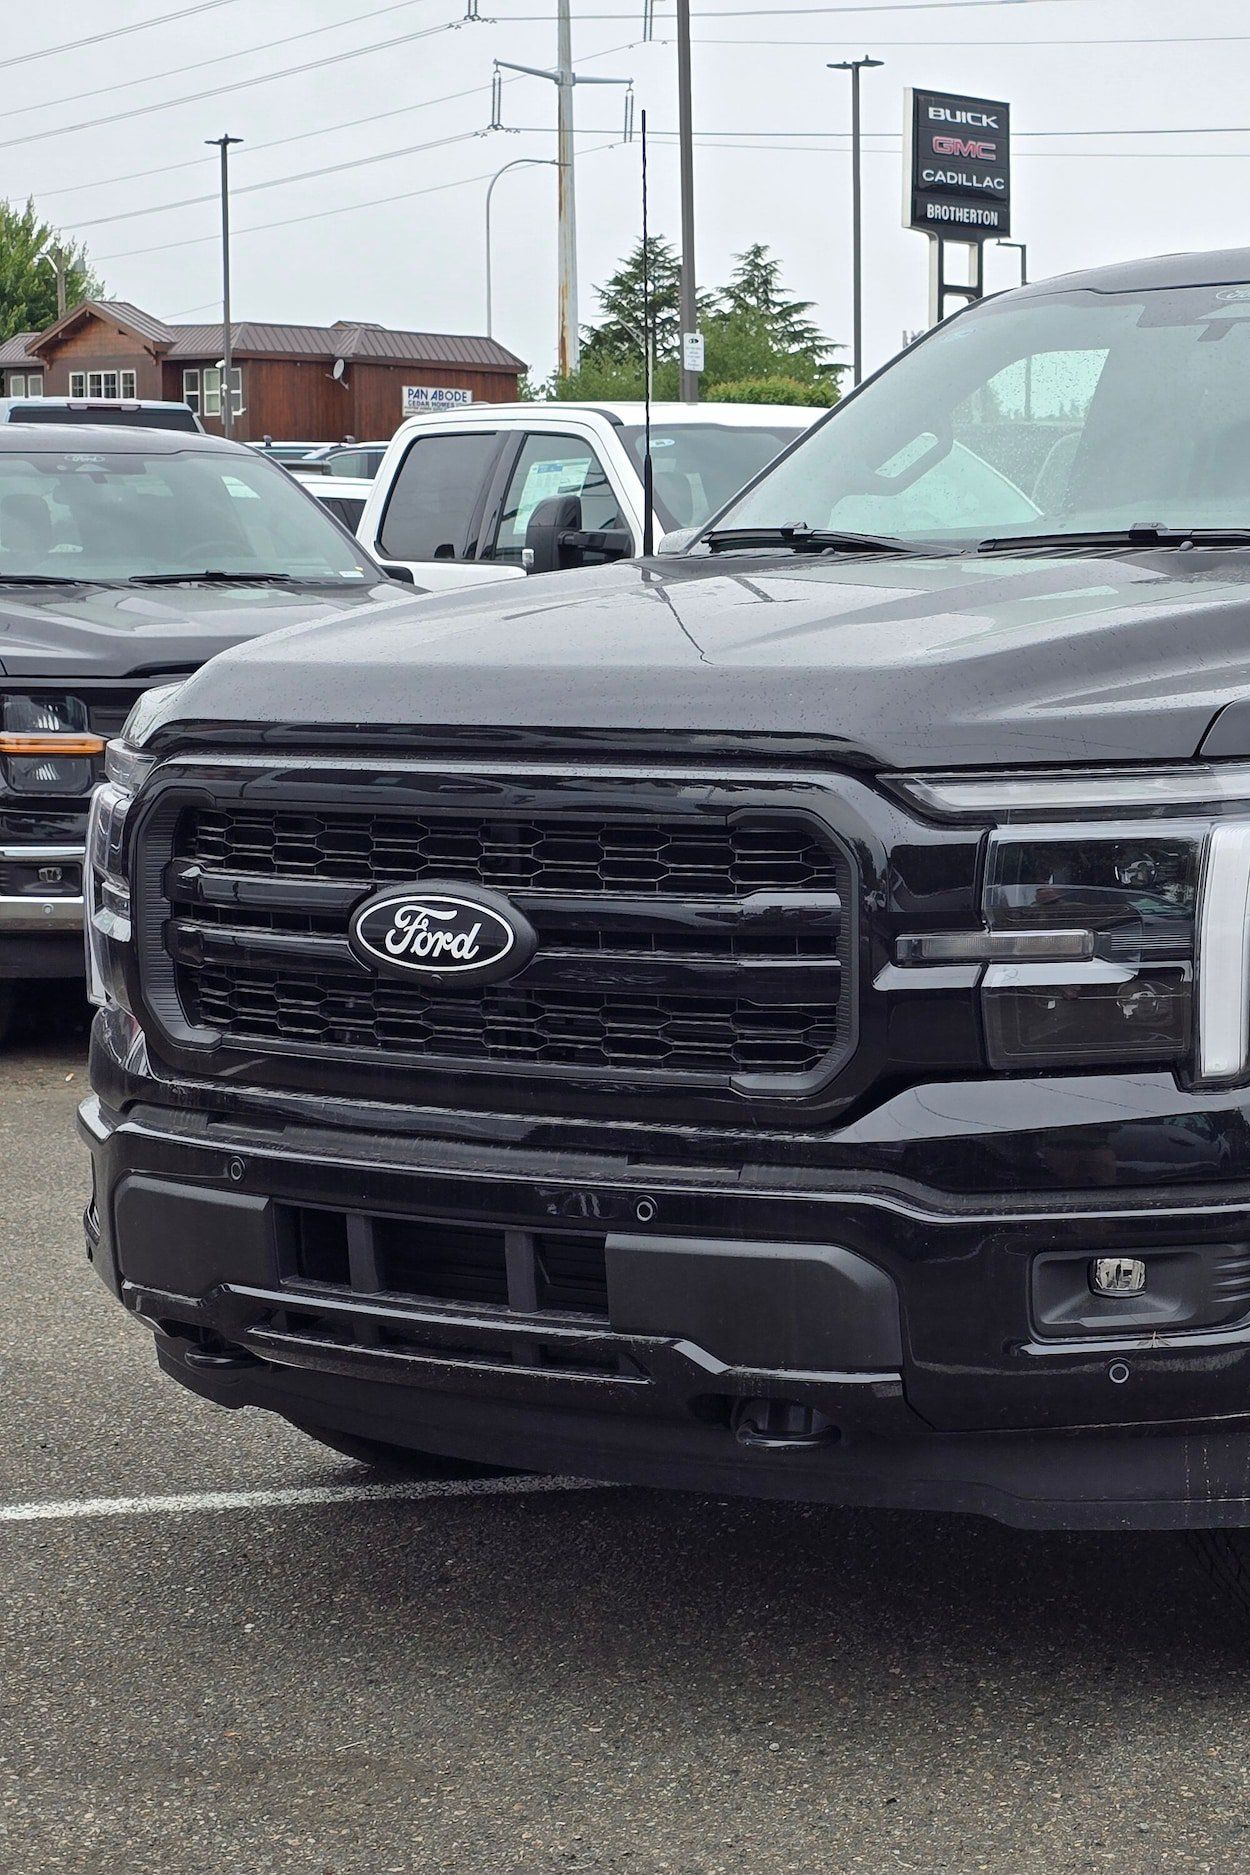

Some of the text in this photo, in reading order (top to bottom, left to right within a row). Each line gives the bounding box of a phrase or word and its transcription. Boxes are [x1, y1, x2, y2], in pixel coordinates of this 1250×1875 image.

[928, 106, 999, 128] BUICK
[932, 135, 996, 160] GMC
[922, 169, 1005, 190] CADILLAC
[926, 203, 999, 226] BROTHERTON
[407, 388, 467, 403] PAN ABODE
[384, 904, 483, 960] Ford
